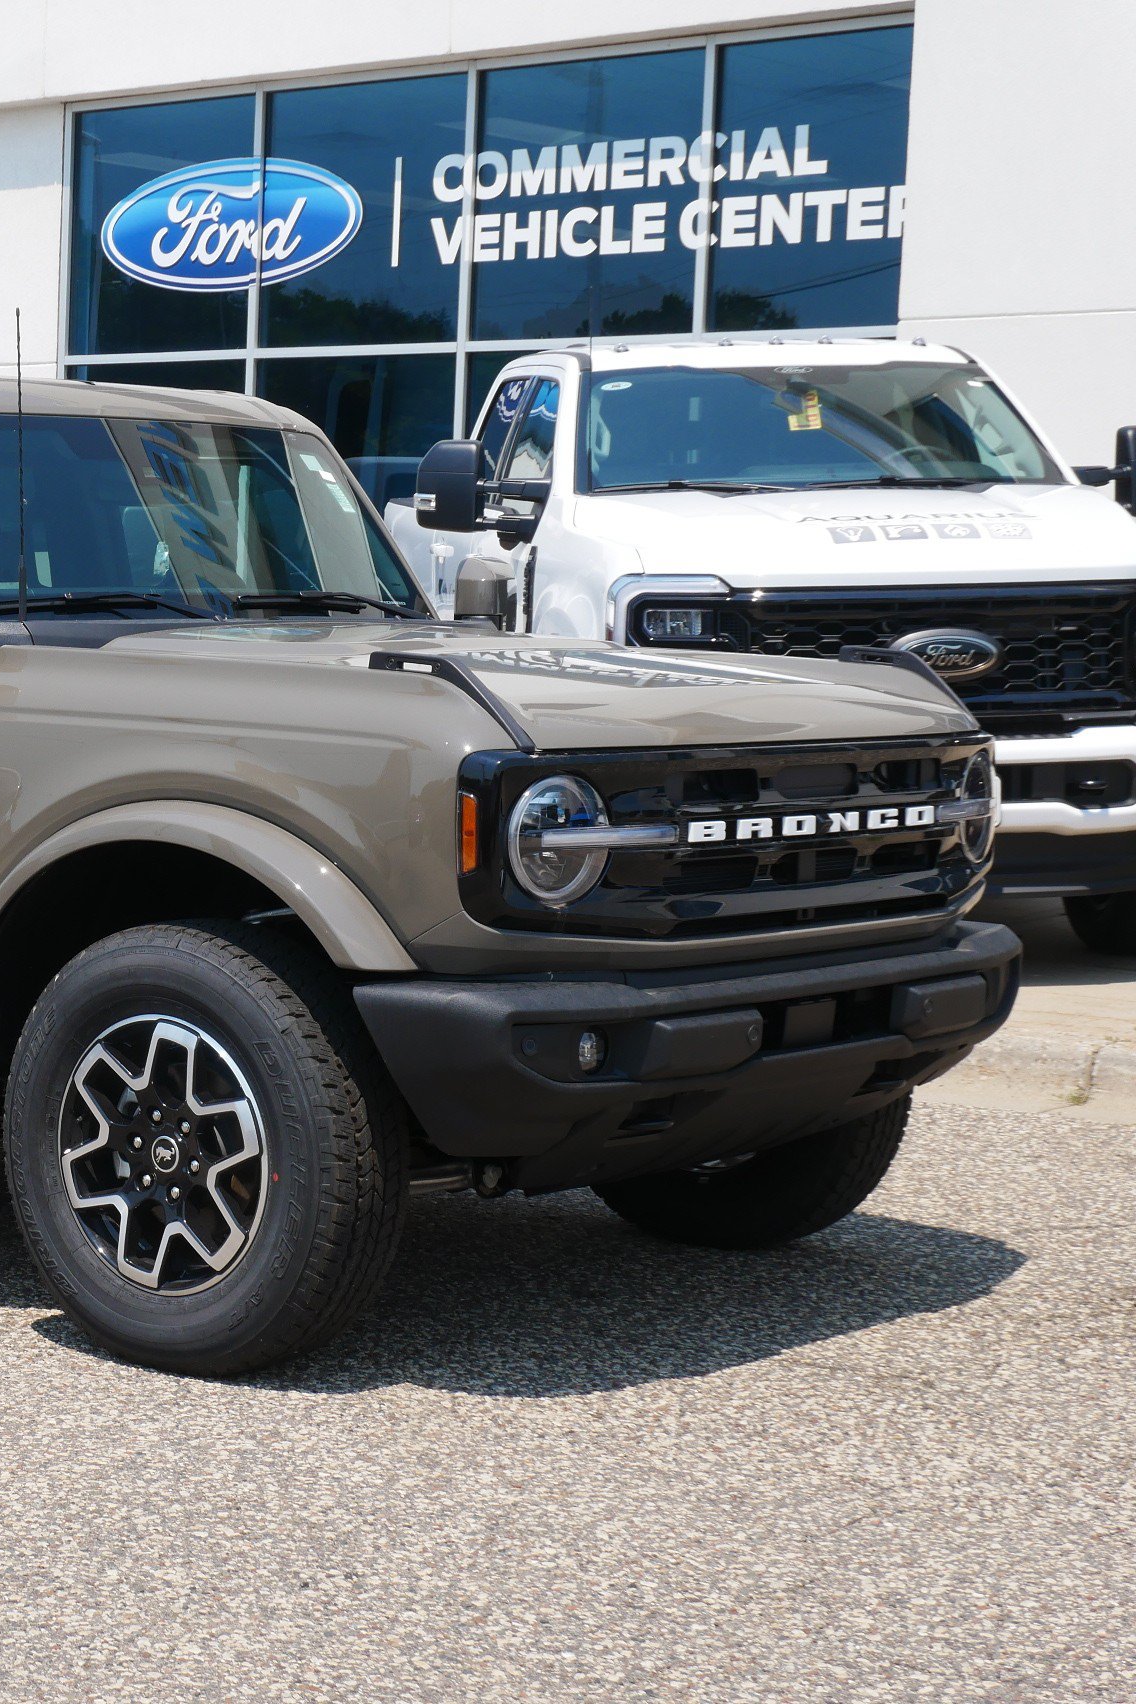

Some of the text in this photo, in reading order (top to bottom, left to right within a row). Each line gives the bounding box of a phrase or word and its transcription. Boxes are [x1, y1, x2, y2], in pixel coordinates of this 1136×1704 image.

[432, 124, 828, 202] COMMERCIAL
[151, 182, 307, 268] Ford
[430, 202, 667, 265] VEHICLE
[796, 513, 1038, 523] AQUARIUS
[923, 644, 976, 667] Ford
[688, 806, 935, 843] BRONCO
